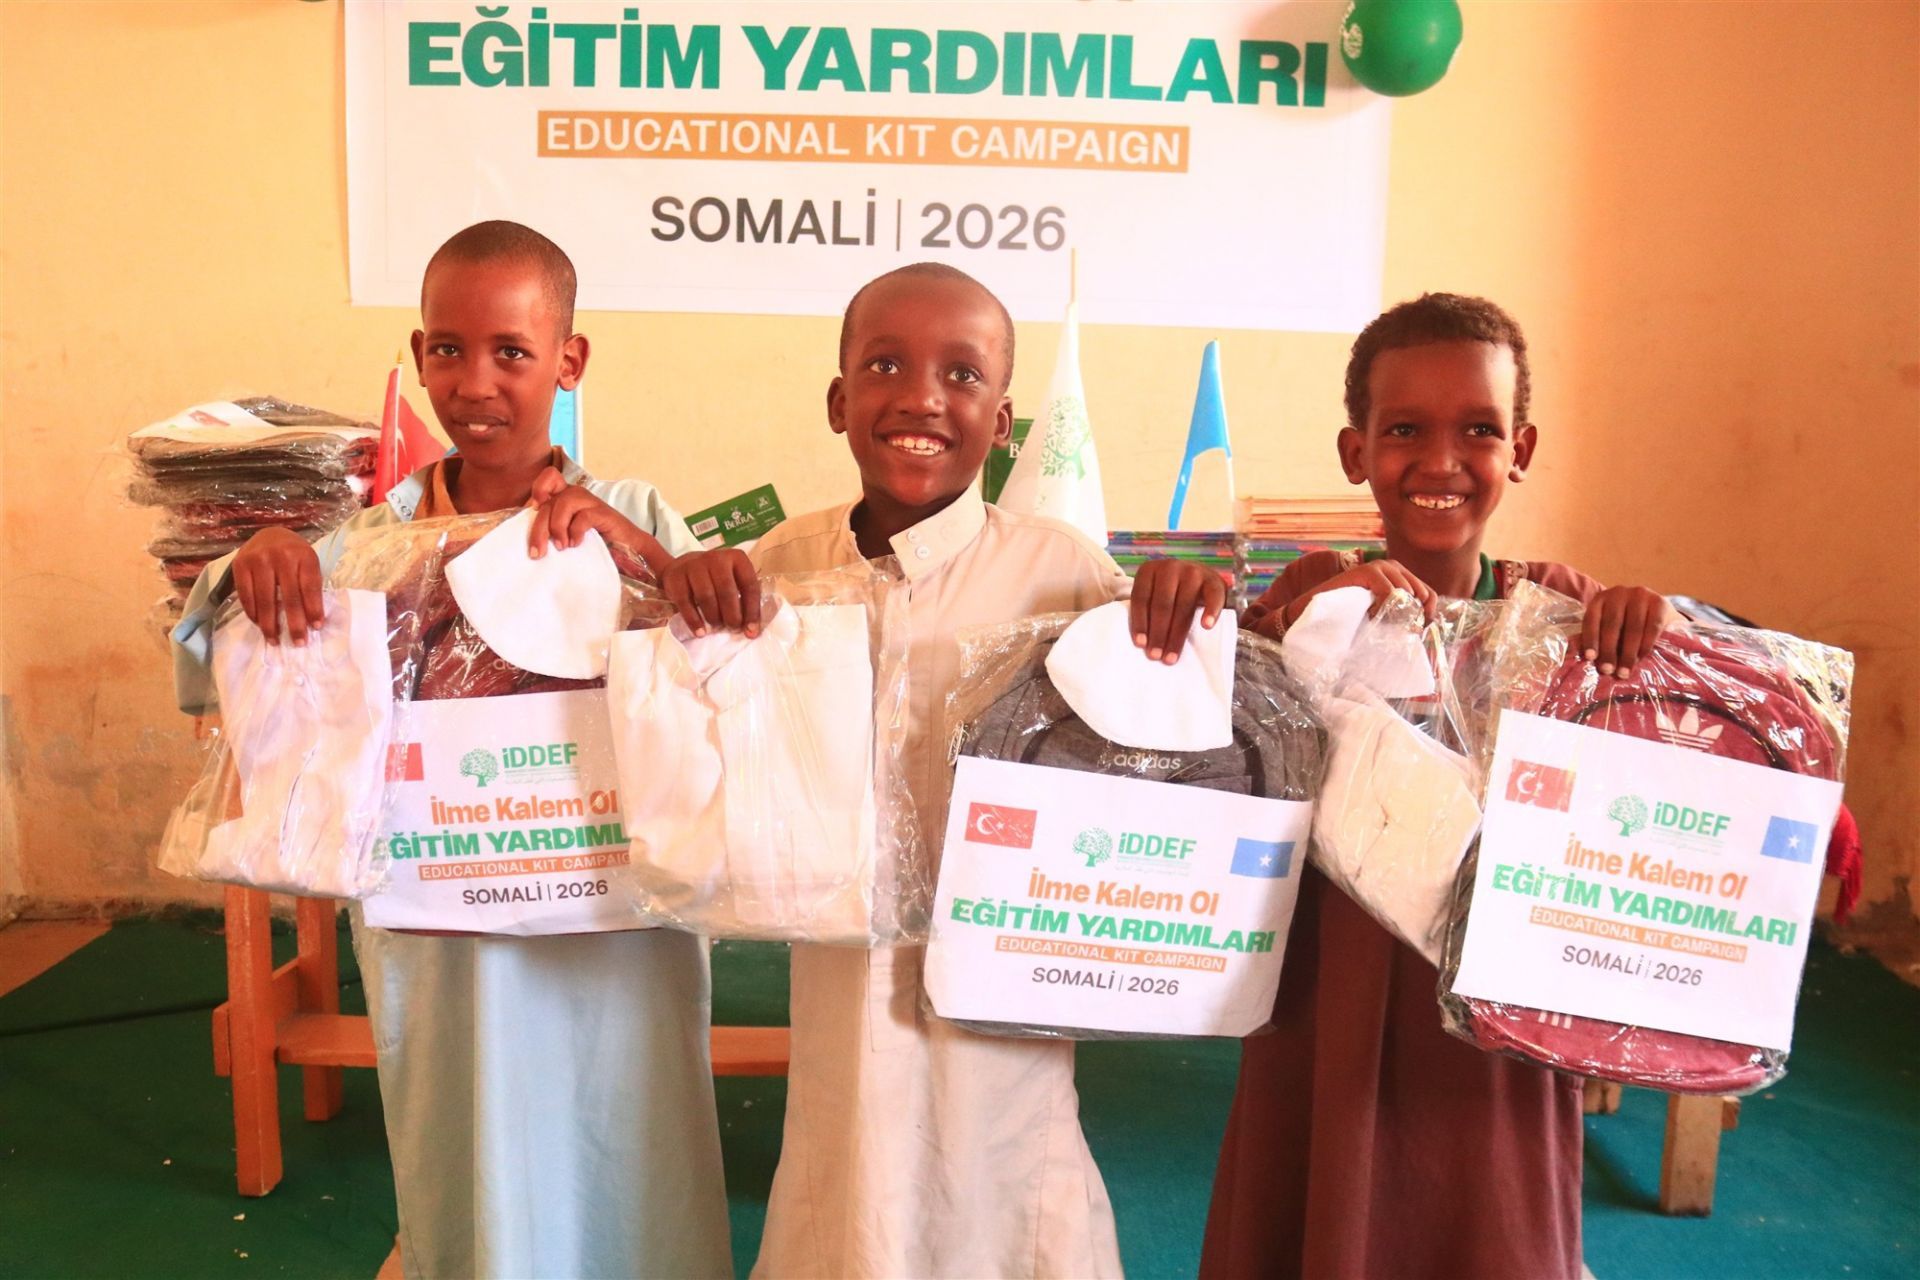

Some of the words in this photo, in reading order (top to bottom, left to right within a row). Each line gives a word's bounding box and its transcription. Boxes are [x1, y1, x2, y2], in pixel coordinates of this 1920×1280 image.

[408, 6, 720, 89] EĞİTİM
[742, 25, 1328, 108] YARDIMLARI
[547, 117, 849, 156] EDUCATIONAL
[867, 123, 936, 158] KIT
[951, 124, 1181, 166] CAMPAIGN
[651, 188, 877, 247] SOMALİ
[920, 201, 1067, 252] 2026
[430, 796, 490, 825] İlme
[495, 795, 584, 822] Kalem
[372, 829, 480, 860] ĞİTİM
[484, 822, 632, 854] YARDIML
[421, 861, 528, 879] EDUCATIONAL
[533, 858, 557, 872] KIT
[562, 852, 631, 870] CAMPAIG
[1627, 852, 1714, 895] Kalem
[462, 881, 543, 904] SOMALİ
[556, 879, 608, 899] 2026
[1028, 867, 1091, 903] İlme
[1095, 881, 1184, 912] Kalem
[1492, 862, 1603, 909] EĞİTİM
[1609, 886, 1798, 946] YARDIMLARI
[950, 897, 1070, 933] EĞİTİM
[1077, 912, 1276, 953] YARDIMLARI
[1532, 908, 1639, 942] EDUCATIONAL
[1643, 929, 1669, 945] KIT
[1671, 935, 1744, 961] CAMPAIGN
[998, 937, 1109, 960] EDUCATIONAL
[1113, 949, 1141, 962] KIT
[1144, 951, 1224, 971] CAMPAIGN
[1562, 945, 1645, 976] SOMALİ
[1653, 962, 1704, 986] 2026
[1031, 967, 1116, 989] SOMALİ
[1127, 975, 1180, 995] 2026
